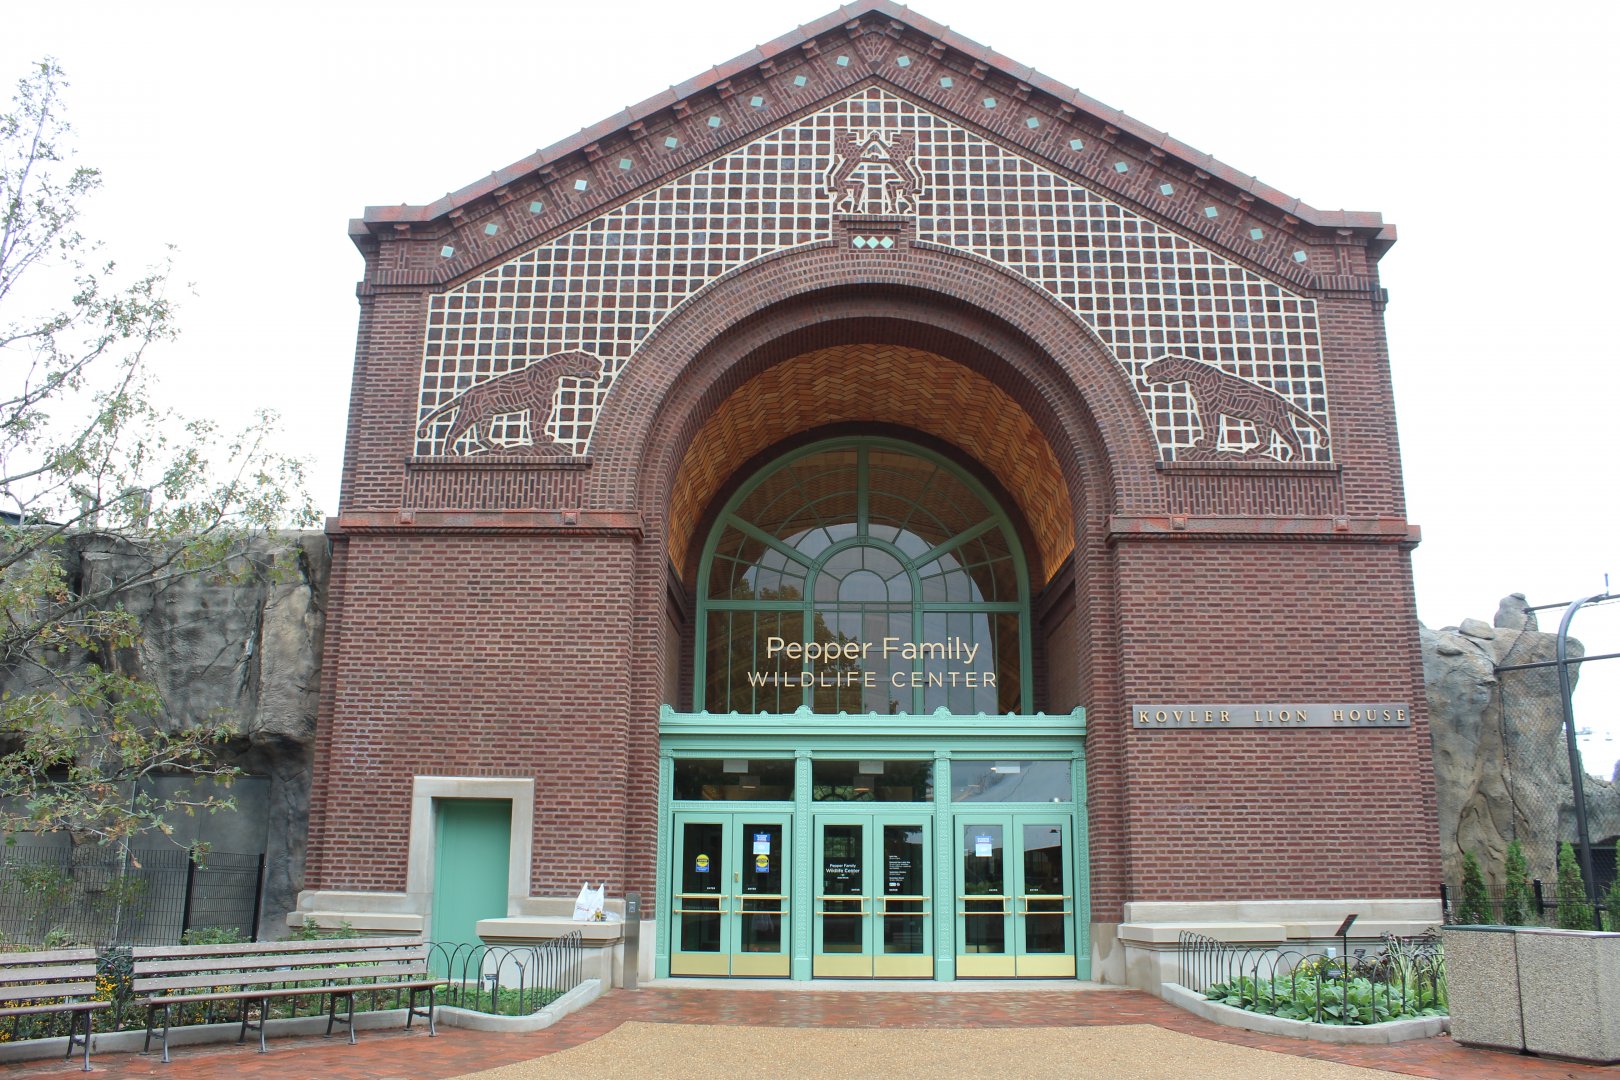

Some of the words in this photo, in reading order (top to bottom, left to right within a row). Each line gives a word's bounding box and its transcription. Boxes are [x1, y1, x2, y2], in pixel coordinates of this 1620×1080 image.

[766, 636, 873, 664] Pepper
[883, 636, 979, 665] Family
[747, 671, 877, 688] WILDLIFE
[891, 671, 997, 688] CENTER
[1138, 710, 1230, 723] KOVLER
[1254, 710, 1308, 722] LION
[1332, 709, 1406, 721] HOUSE
